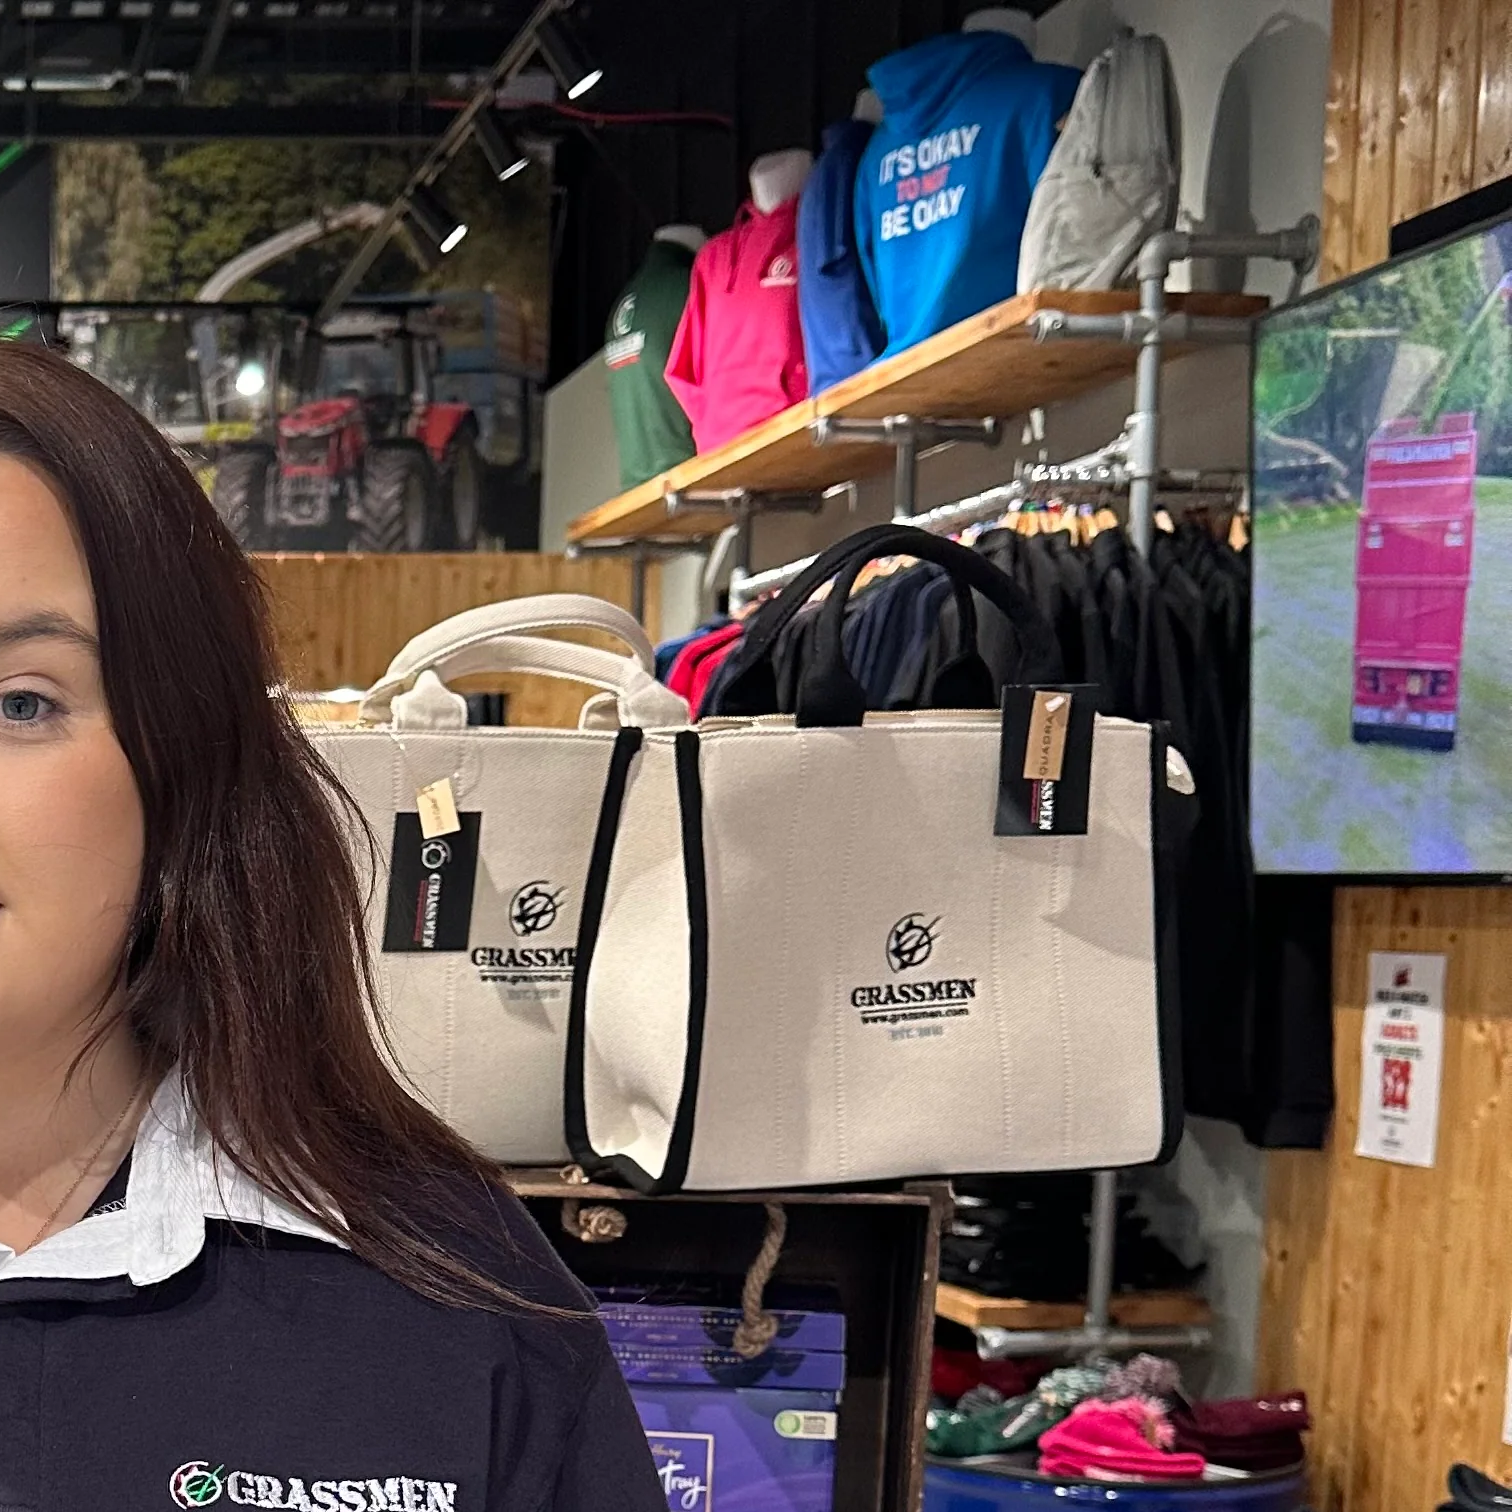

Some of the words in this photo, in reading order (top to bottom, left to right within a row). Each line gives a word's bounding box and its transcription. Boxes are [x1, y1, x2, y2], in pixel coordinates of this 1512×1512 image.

[917, 123, 982, 171] OKAY
[880, 203, 911, 241] BE
[912, 184, 966, 231] OKAY
[896, 177, 920, 203] TO
[1038, 714, 1054, 776] QUADRA
[851, 978, 977, 1008] GRASSMEN
[658, 1459, 707, 1510] Tray
